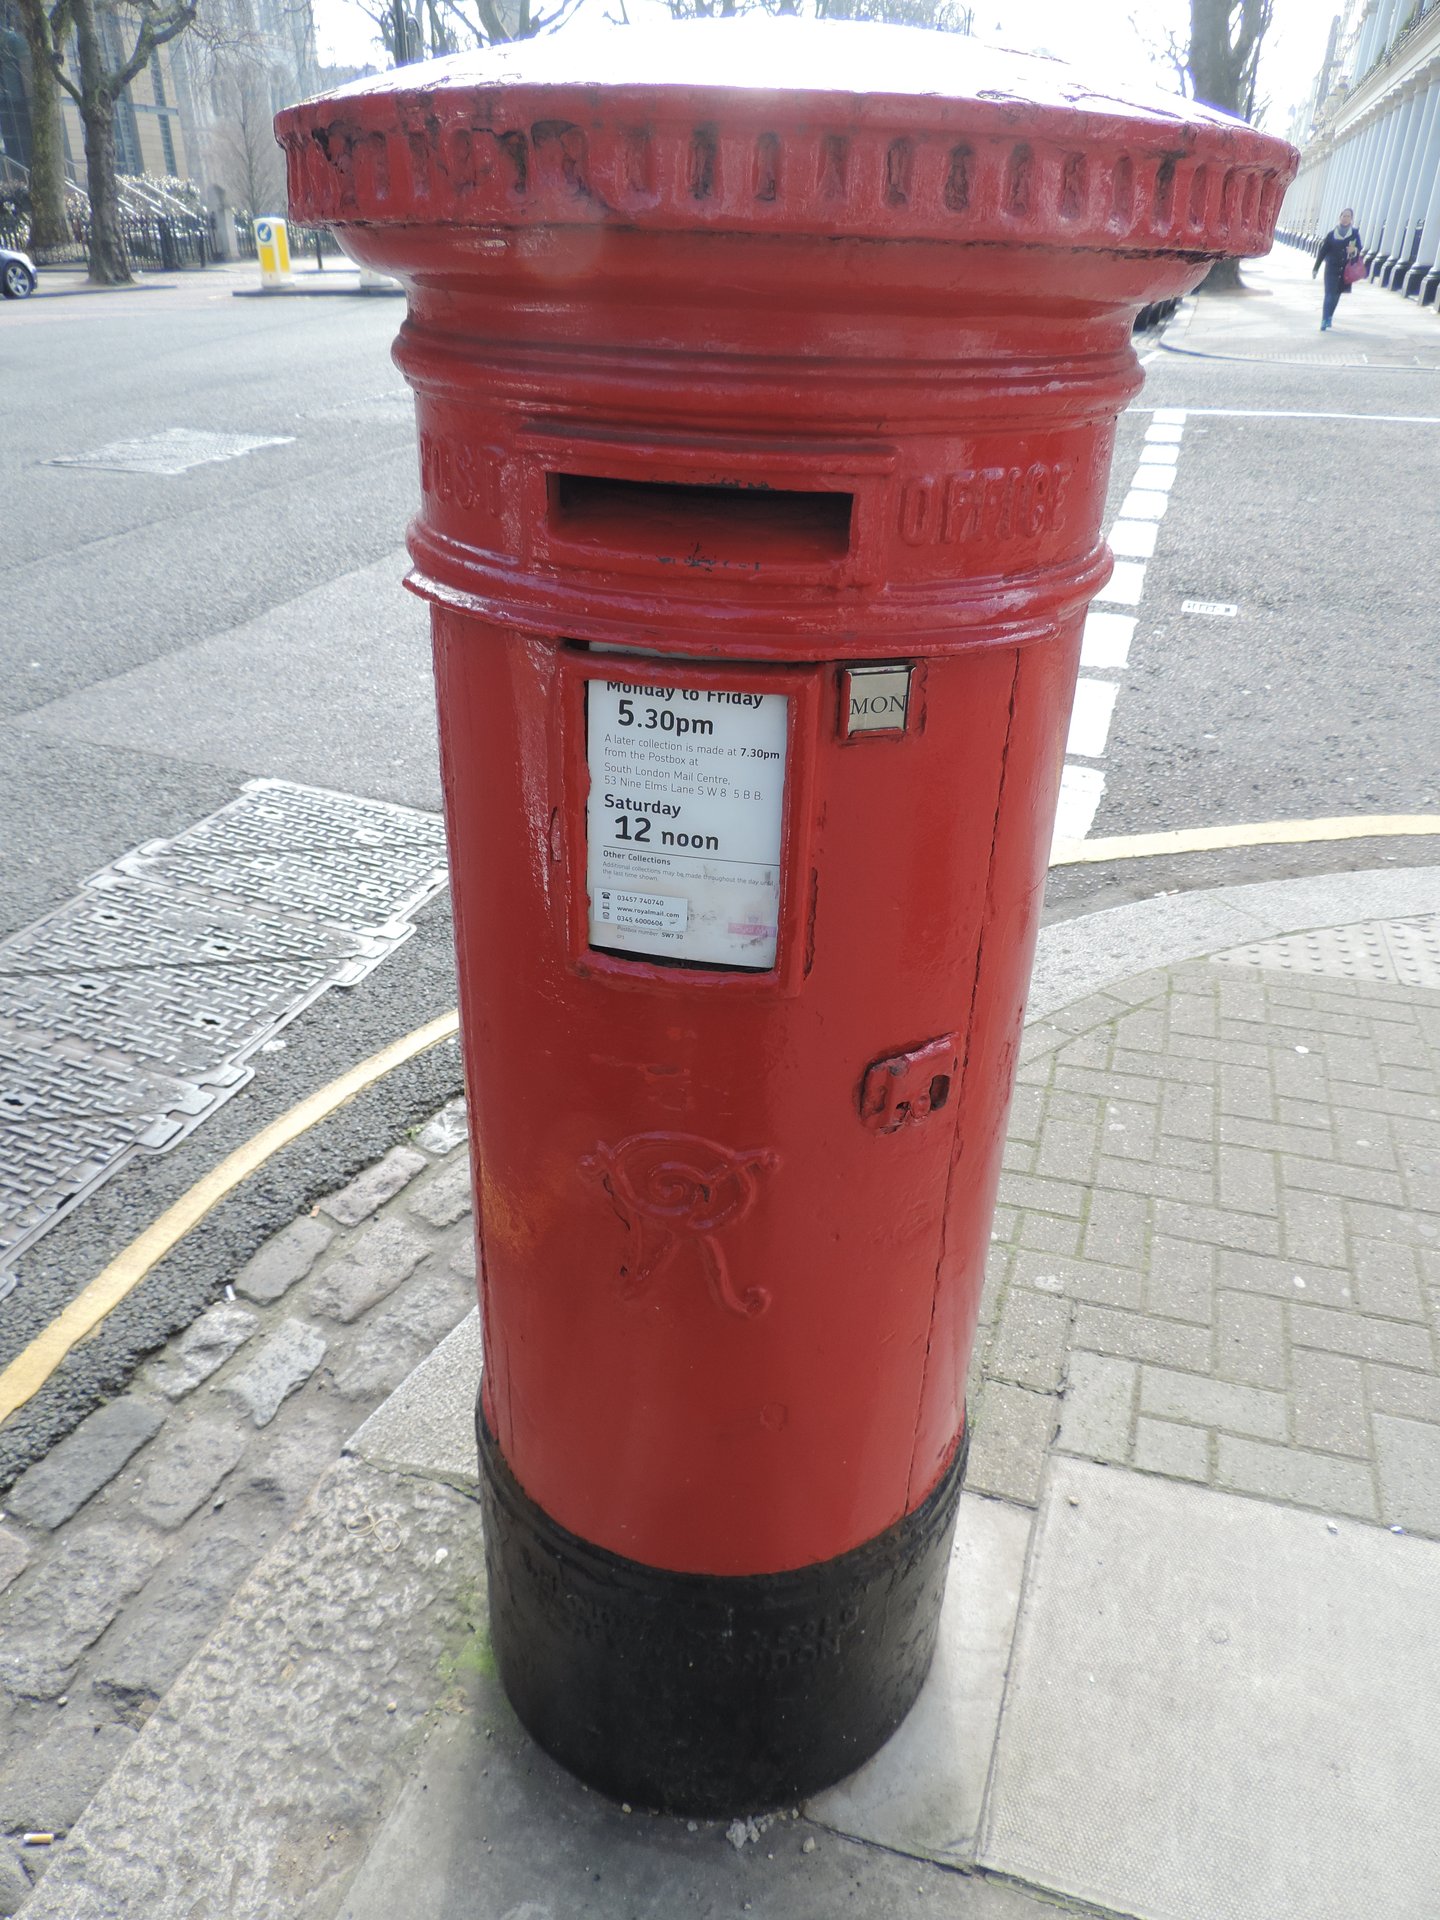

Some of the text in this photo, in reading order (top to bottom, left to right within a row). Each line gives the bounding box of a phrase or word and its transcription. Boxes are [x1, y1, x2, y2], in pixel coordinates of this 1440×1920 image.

[682, 688, 699, 701] to
[850, 695, 907, 715] MON
[618, 699, 713, 737] 5.30pm
[604, 734, 780, 760] A later collection is made at 7.30pm
[604, 747, 699, 766] from the Postbox at
[604, 762, 731, 785] South London Mail Centre,
[604, 775, 617, 785] 53
[620, 777, 642, 788] Nine
[645, 780, 668, 792] Elms
[671, 783, 694, 795] Lane
[604, 794, 681, 818] Saturday
[615, 815, 719, 850] 12 noon
[603, 850, 671, 866] Other Collections
[602, 861, 630, 870] Additional
[632, 865, 661, 875] collections
[663, 869, 675, 877] may
[602, 868, 612, 876] the
[616, 894, 665, 907] 03457 740740
[616, 905, 680, 918] www.royalmail.com
[616, 914, 633, 923] 0345
